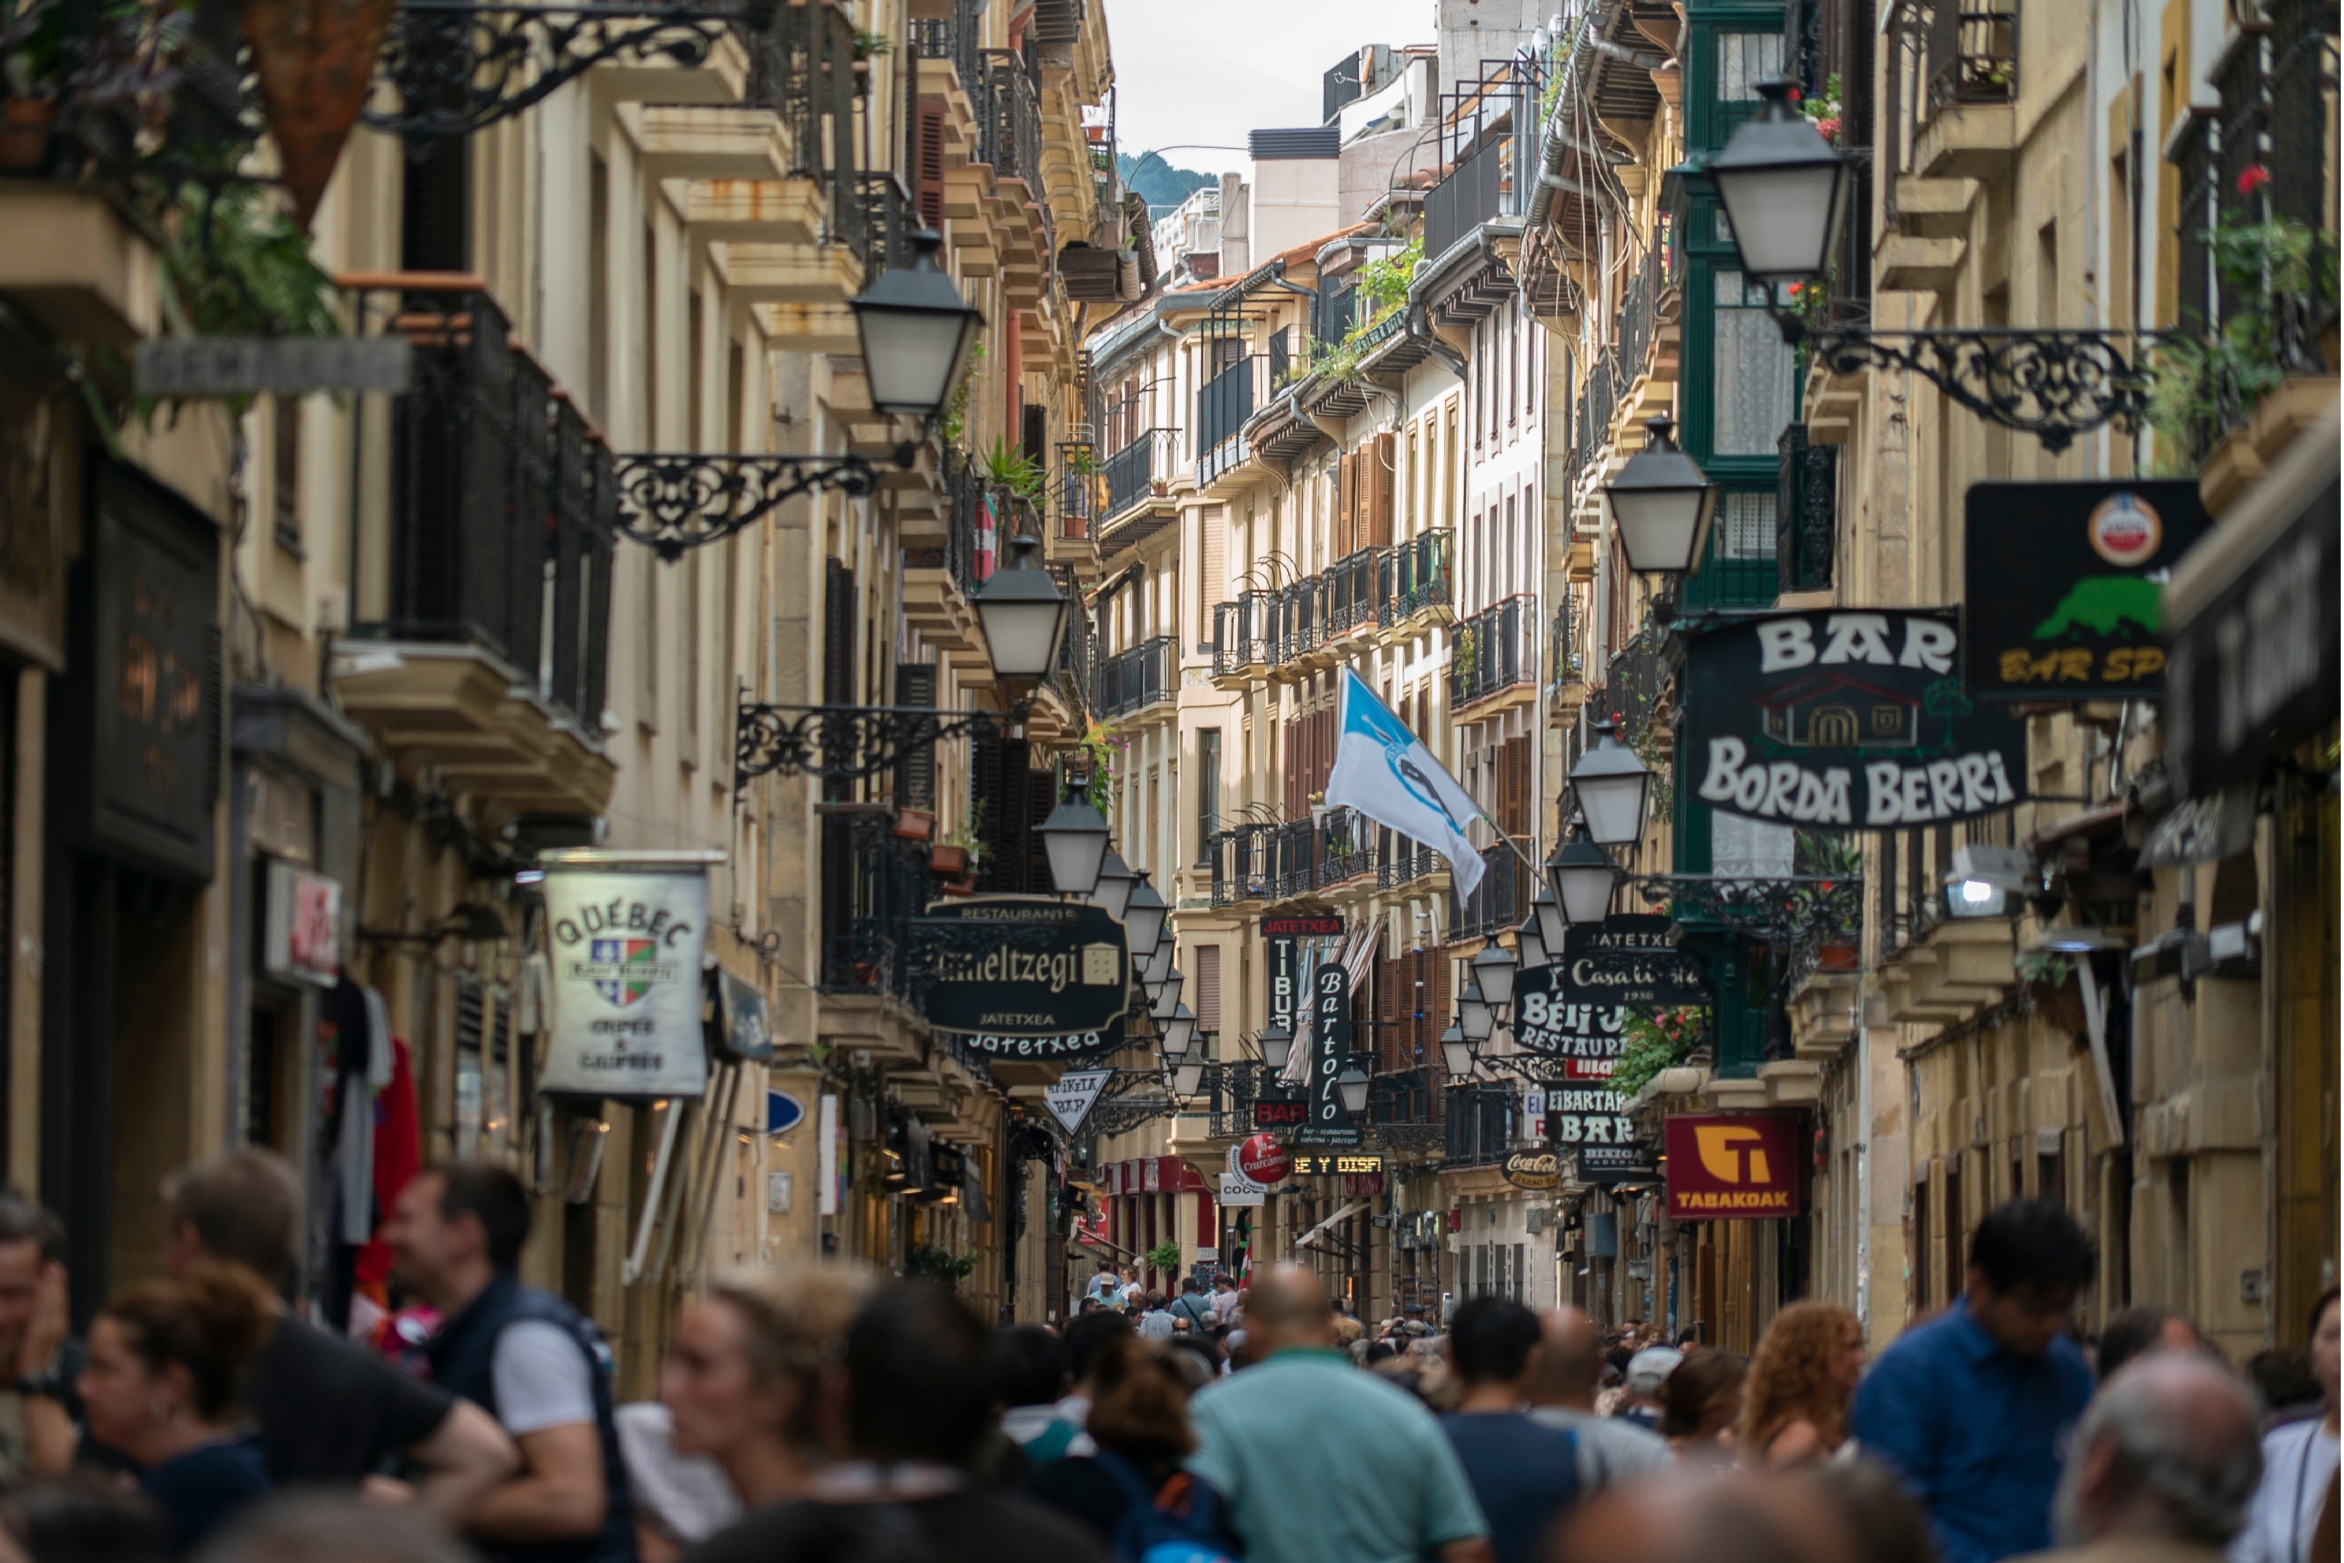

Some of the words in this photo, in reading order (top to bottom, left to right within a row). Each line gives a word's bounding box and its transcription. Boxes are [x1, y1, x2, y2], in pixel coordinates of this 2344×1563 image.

[1757, 613, 1956, 675] BAR
[1999, 647, 2094, 683] BAR
[2101, 646, 2169, 682] SP
[1699, 736, 1853, 825] BORDA
[555, 896, 692, 948] QUÉBEC
[1263, 919, 1341, 934] JATETXEA
[1571, 958, 1630, 986] Casa
[979, 1013, 1055, 1025] JATETXEA
[1320, 971, 1342, 1120] Bartolo
[1053, 1099, 1086, 1114] BAR
[1257, 1103, 1306, 1123] BAR
[1560, 1115, 1635, 1144] BAR
[1243, 1156, 1290, 1172] Cruzcamp
[1318, 1157, 1331, 1173] Y
[1677, 1191, 1789, 1209] TABAKOAK
